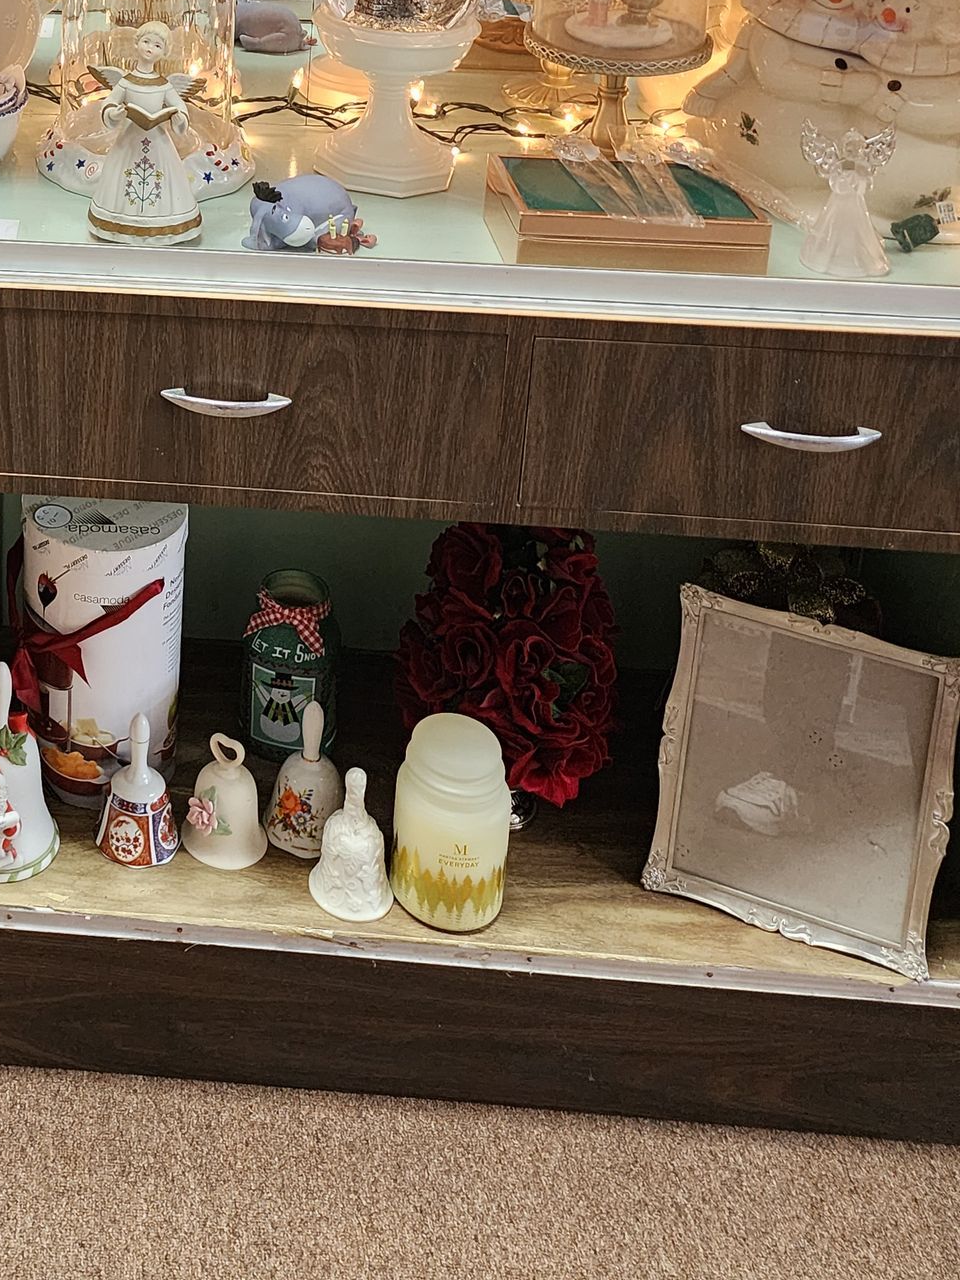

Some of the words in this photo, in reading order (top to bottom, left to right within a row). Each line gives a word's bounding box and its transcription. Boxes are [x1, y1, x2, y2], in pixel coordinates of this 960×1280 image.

[67, 524, 161, 535] casamoda
[73, 592, 130, 605] casamoda
[251, 630, 270, 655] LET
[271, 646, 291, 659] IT
[453, 843, 468, 856] M
[438, 858, 480, 869] EVERYDAY
